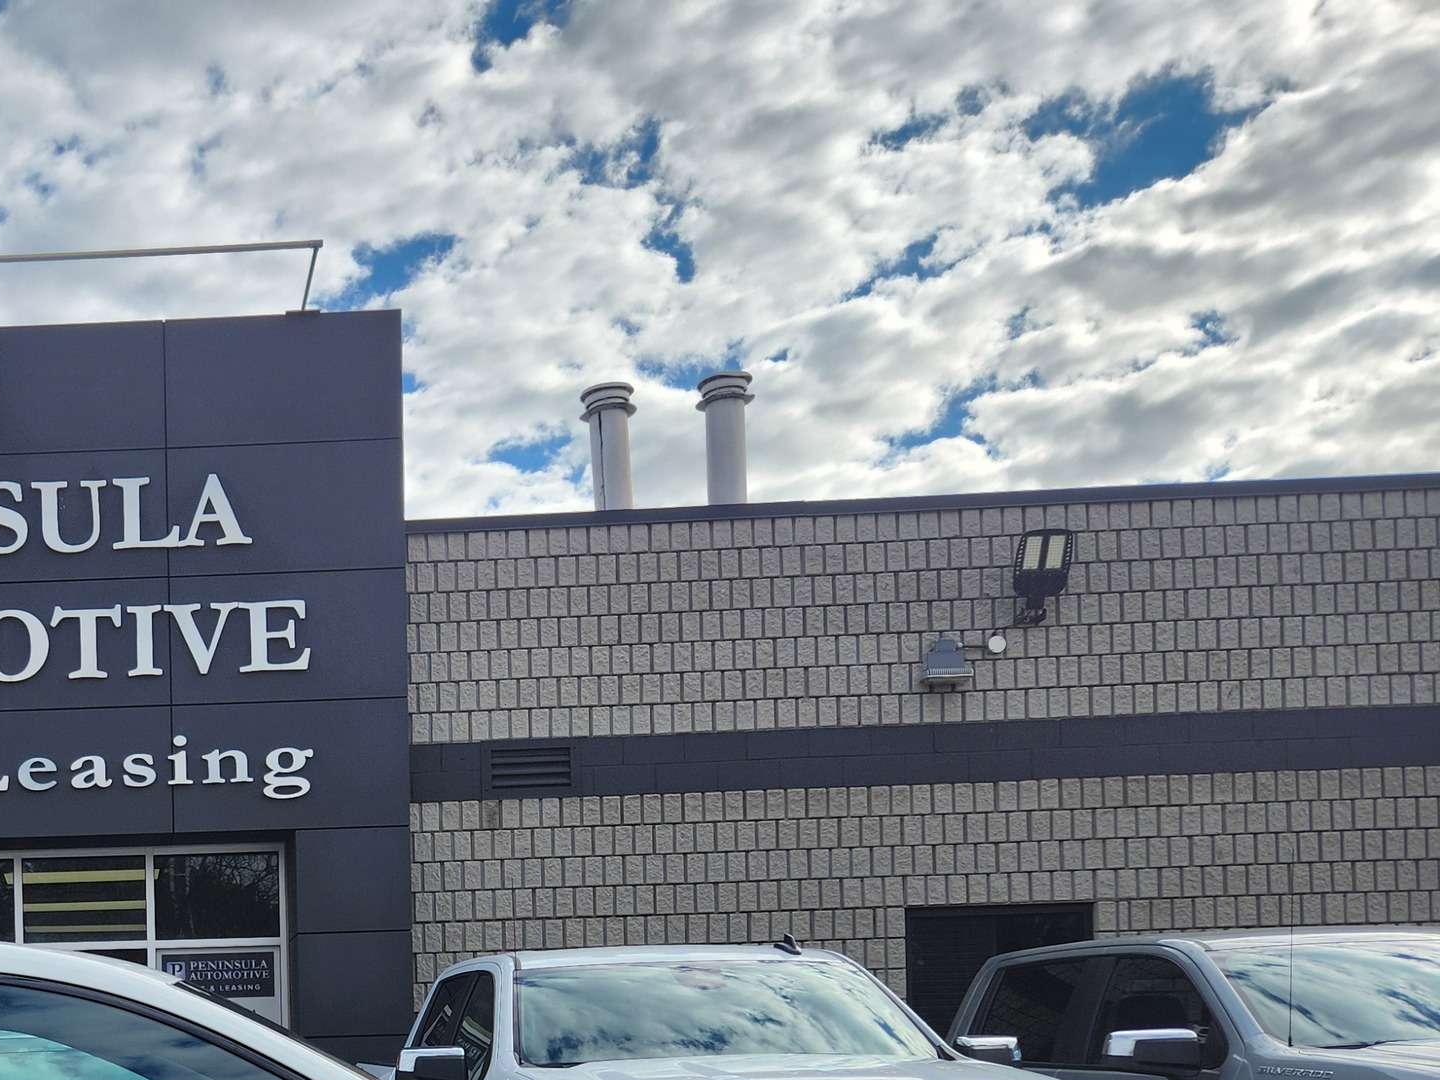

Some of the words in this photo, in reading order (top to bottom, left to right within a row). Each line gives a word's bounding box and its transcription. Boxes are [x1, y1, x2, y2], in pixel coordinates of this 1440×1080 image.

[190, 959, 268, 971] PENINSULA
[189, 970, 271, 981] AUTOMOTIVE
[219, 983, 262, 992] LEASING
